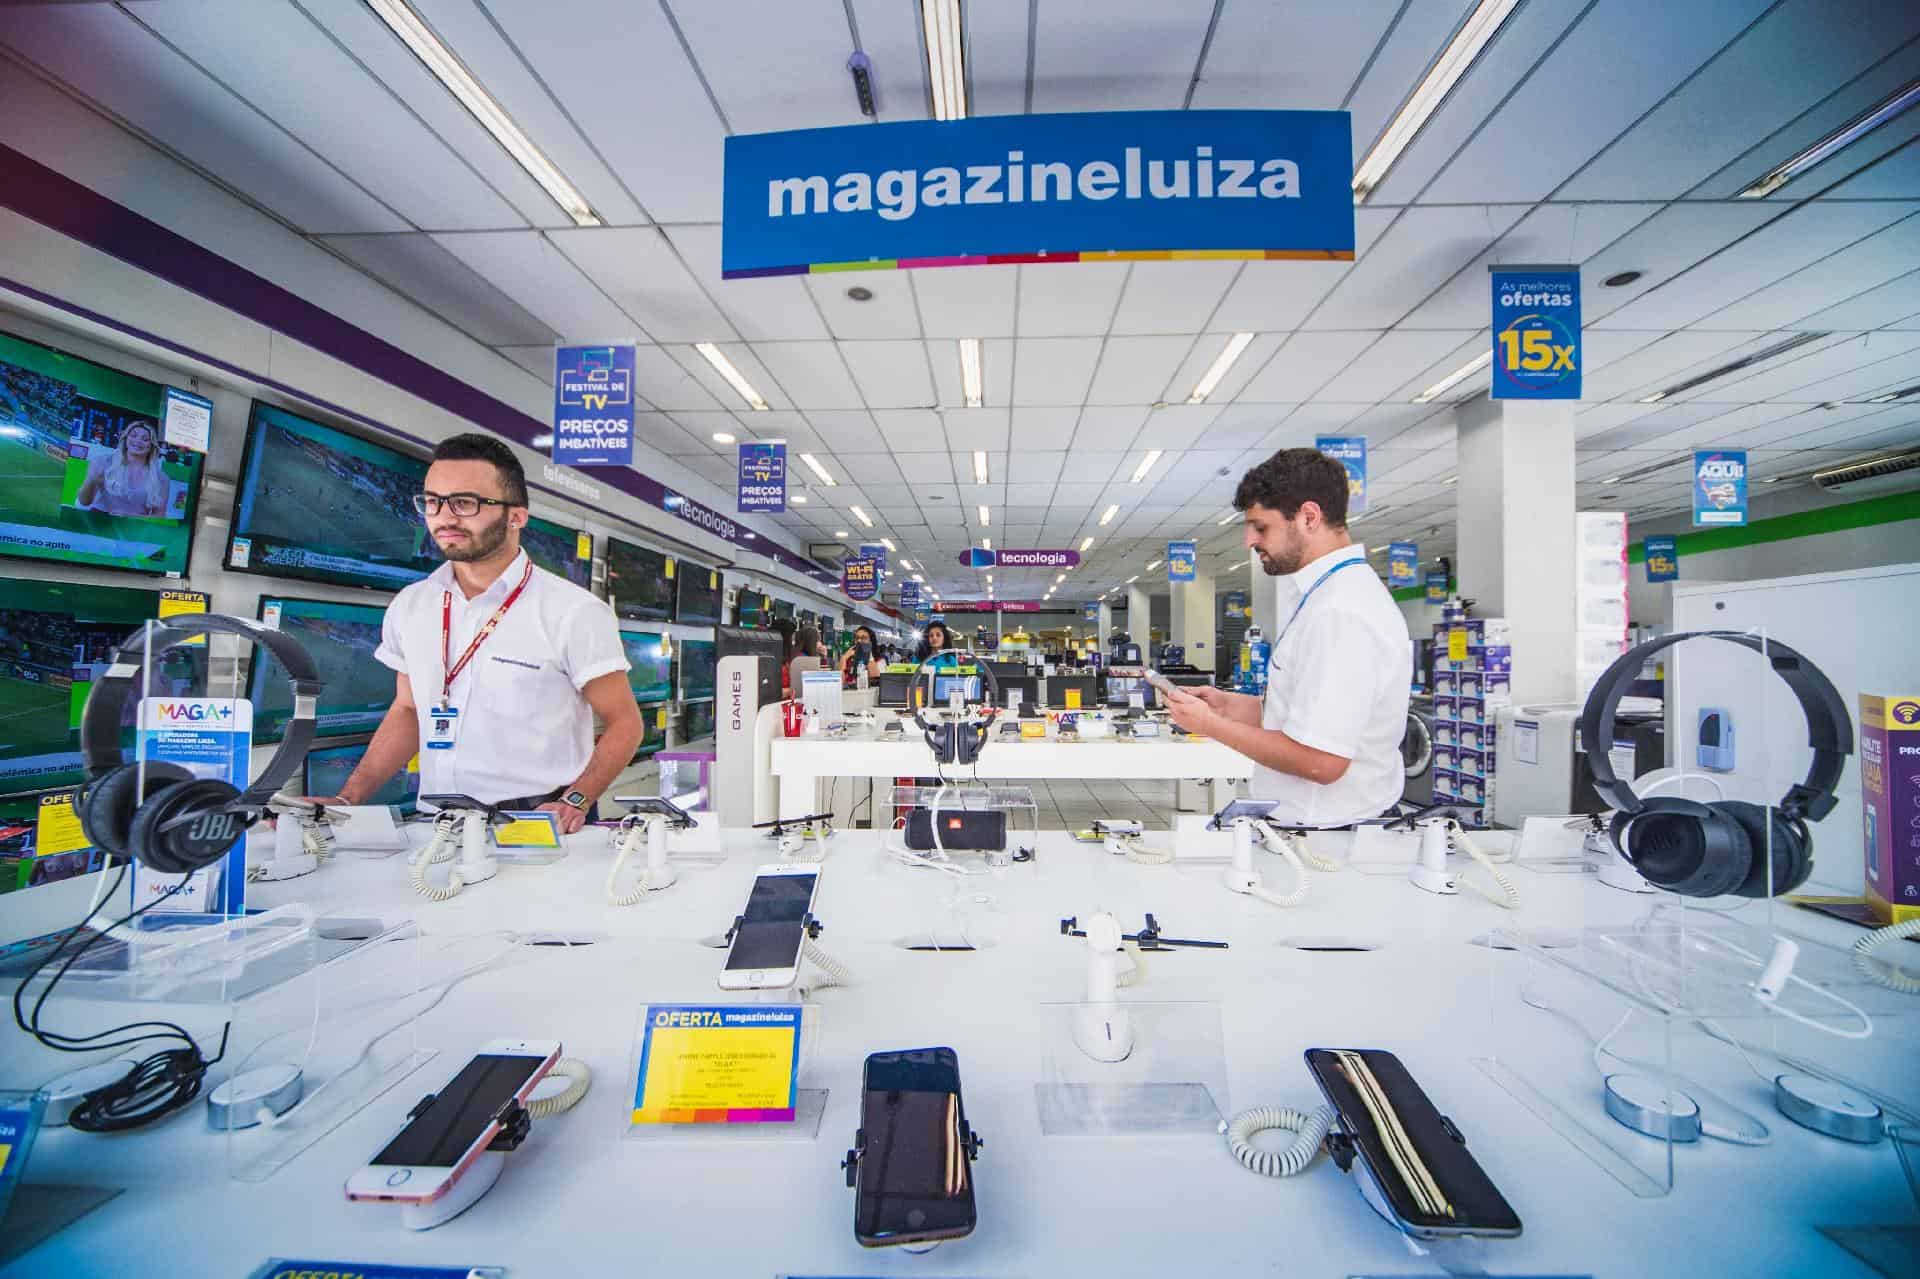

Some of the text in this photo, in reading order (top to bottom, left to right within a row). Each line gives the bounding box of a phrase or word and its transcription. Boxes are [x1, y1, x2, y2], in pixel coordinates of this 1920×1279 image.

[768, 146, 1301, 221] magazineluiza
[1501, 280, 1572, 291] As melhores
[1500, 291, 1572, 306] ofertas
[1498, 329, 1576, 371] 15x
[565, 383, 625, 392] FESTIVAL DE
[582, 394, 608, 410] TV
[559, 419, 629, 435] PREÇOS
[559, 436, 628, 449] IMBATÍVEIS
[754, 471, 770, 481] TV
[741, 486, 783, 496] PREÇOS
[680, 501, 736, 538] tecnologia
[1002, 551, 1067, 564] tecnologia
[162, 590, 205, 602] OFERTA
[732, 671, 742, 730] GAMES
[157, 703, 232, 721] MAGA+
[189, 814, 236, 841] JBL
[655, 1011, 795, 1026] OFERTA magazineluiza
